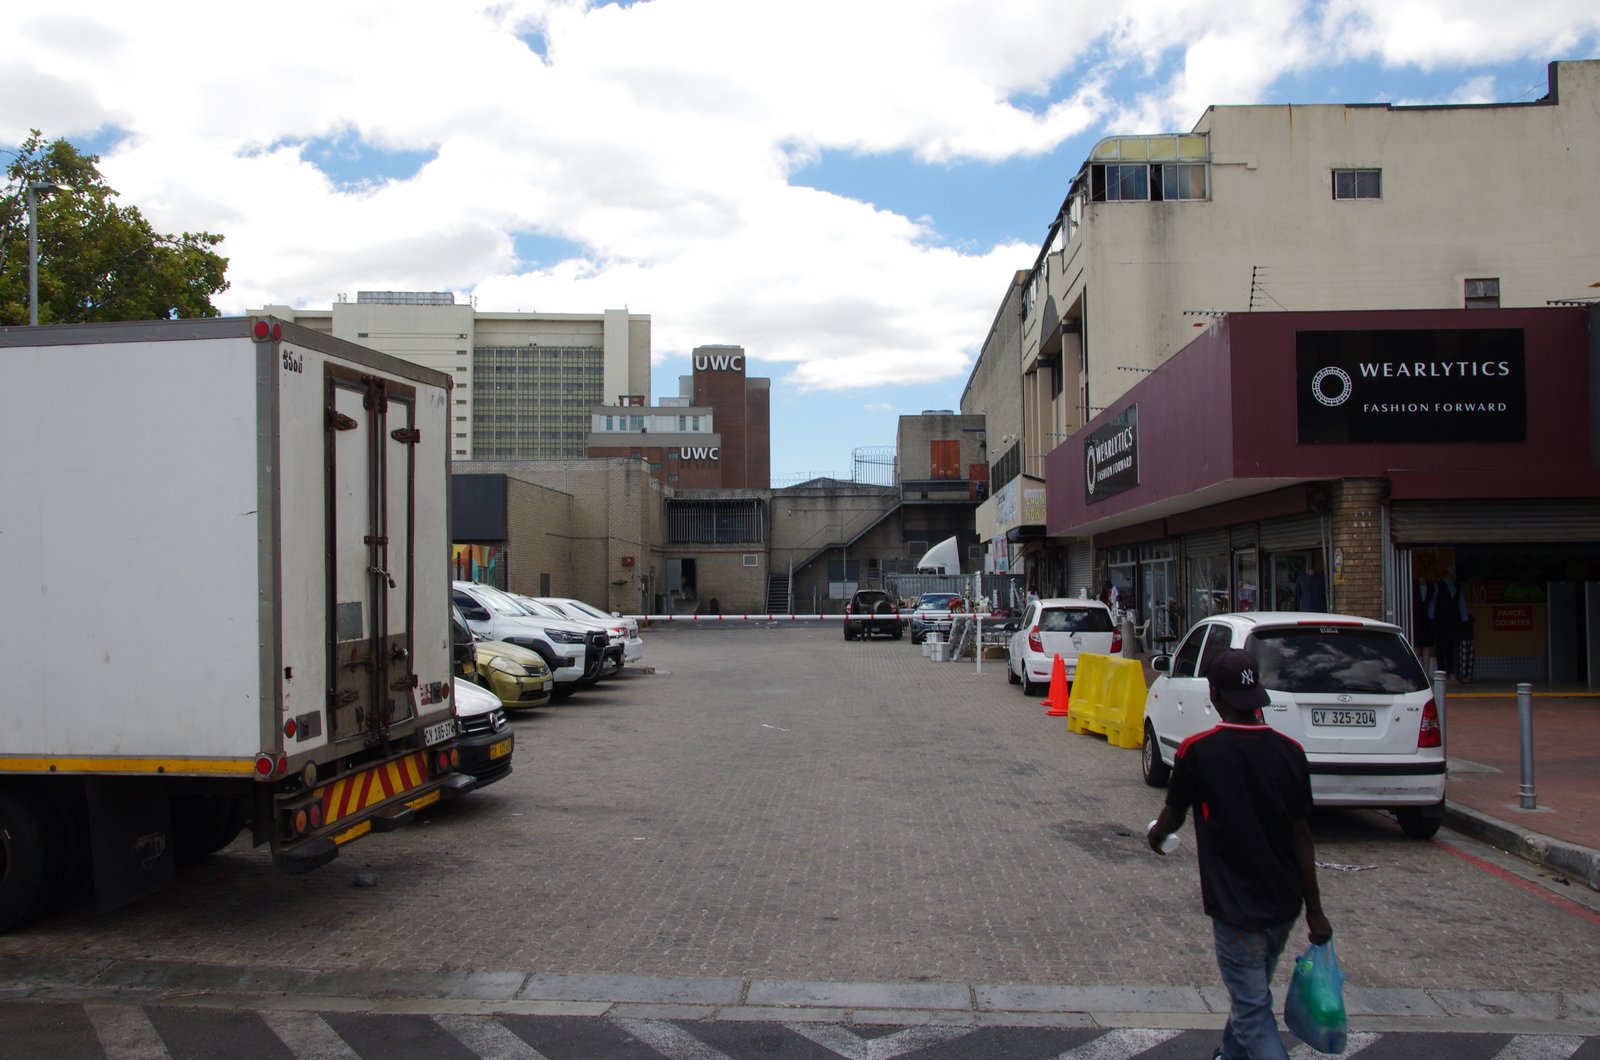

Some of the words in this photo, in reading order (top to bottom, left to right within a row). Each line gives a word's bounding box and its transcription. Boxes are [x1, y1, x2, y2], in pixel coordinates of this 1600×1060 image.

[695, 355, 742, 371] UWC
[1359, 361, 1510, 377] WEARLYTICS
[1363, 403, 1429, 413] FASHION
[1435, 402, 1507, 412] FORWARD
[1095, 426, 1133, 464] WEARLYTICS
[680, 447, 719, 460] UWC
[1097, 465, 1113, 482] FASHION
[1112, 455, 1133, 475] FORWARD
[1498, 608, 1529, 617] PARCEL
[1495, 618, 1532, 627] COUNTER
[1241, 667, 1255, 685] NY
[1313, 710, 1326, 723] CY
